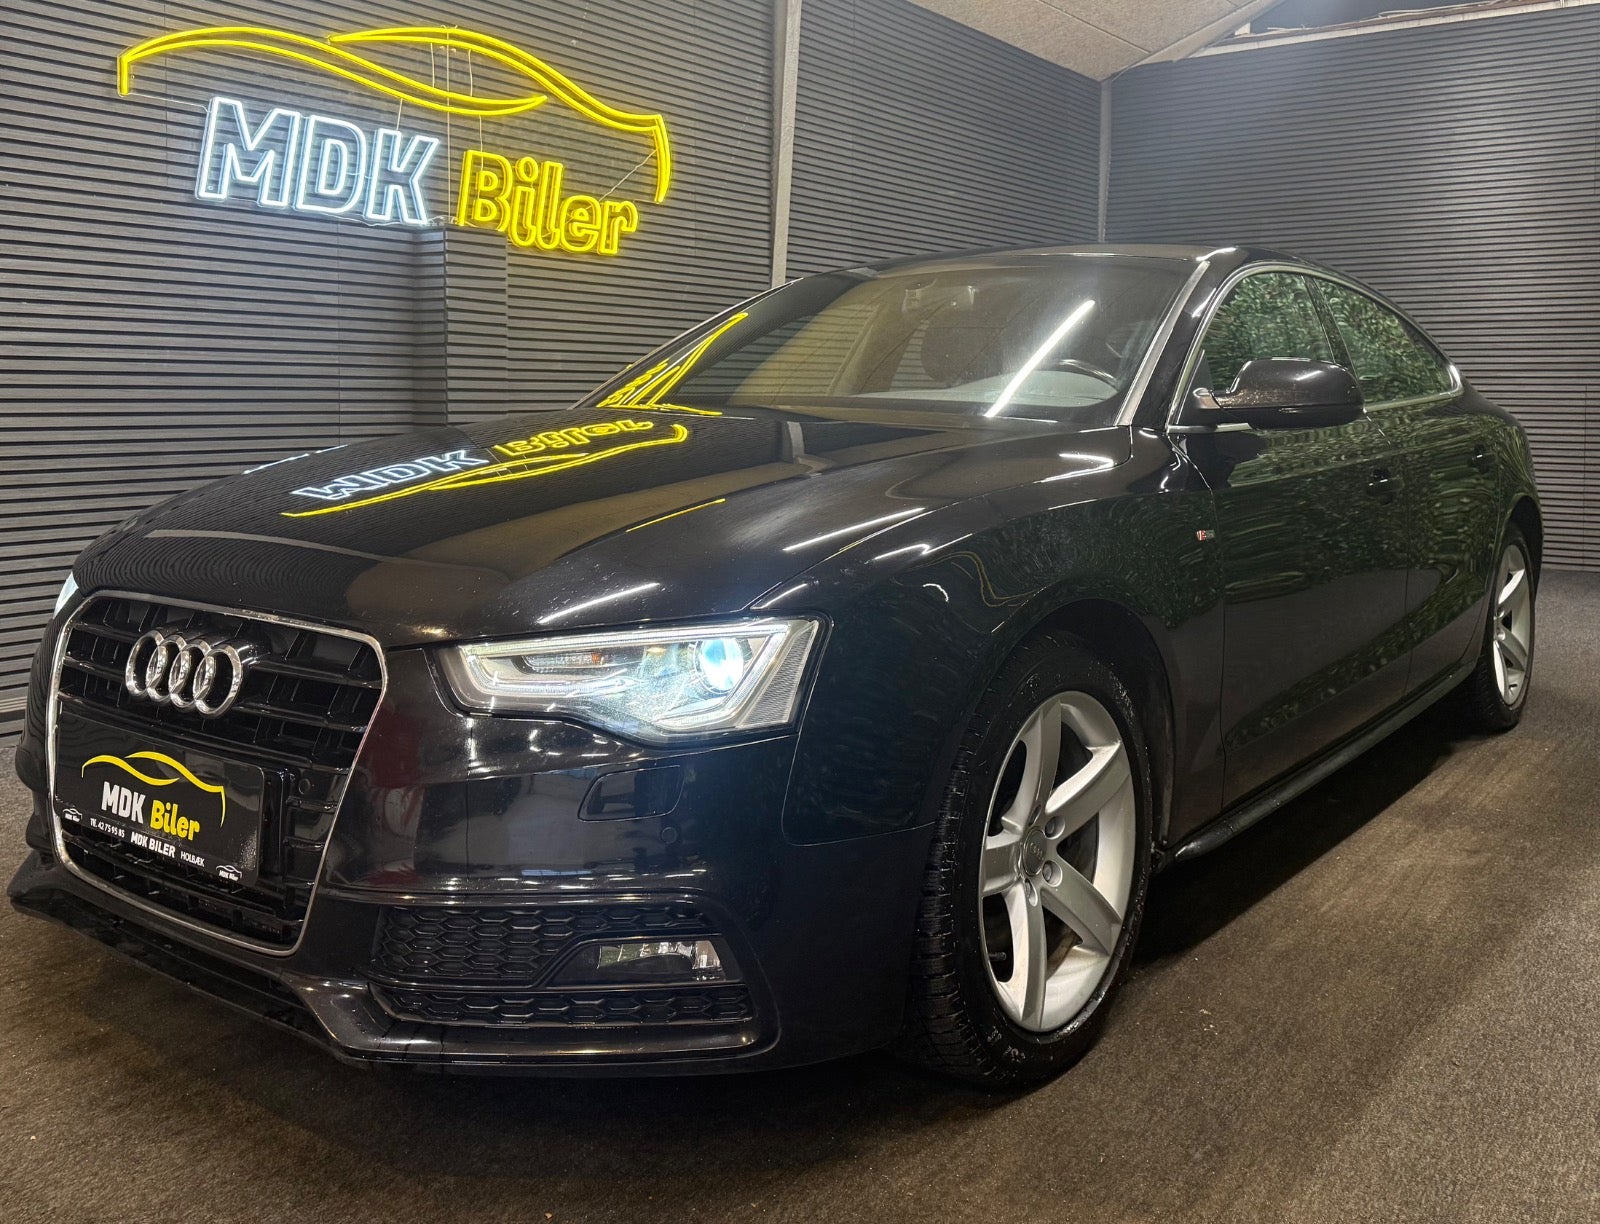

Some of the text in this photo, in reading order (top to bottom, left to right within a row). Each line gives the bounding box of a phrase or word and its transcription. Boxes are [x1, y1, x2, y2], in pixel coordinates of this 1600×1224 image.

[194, 95, 638, 255] MDK Biler
[101, 781, 200, 841] MDK Biler
[130, 831, 149, 848] MDK
[148, 837, 176, 858] BILER
